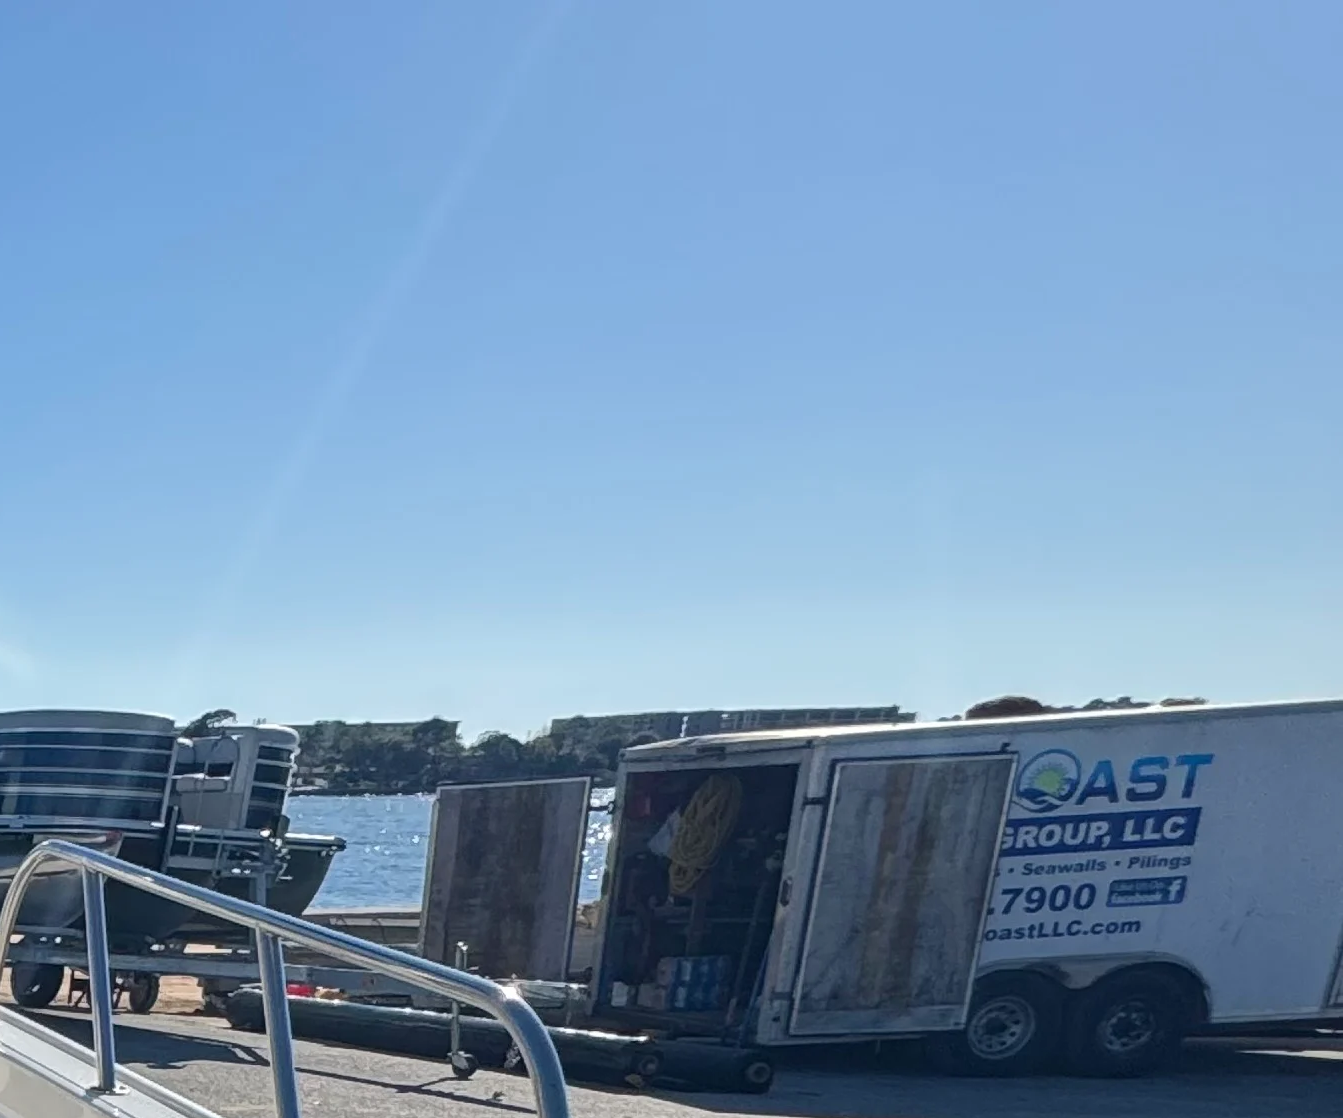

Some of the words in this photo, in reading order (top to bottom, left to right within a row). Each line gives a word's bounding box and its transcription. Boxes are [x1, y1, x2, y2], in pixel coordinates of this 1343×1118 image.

[1122, 815, 1187, 842] LLC
[1021, 858, 1107, 876] Seawalls
[1127, 855, 1191, 871] Pilings
